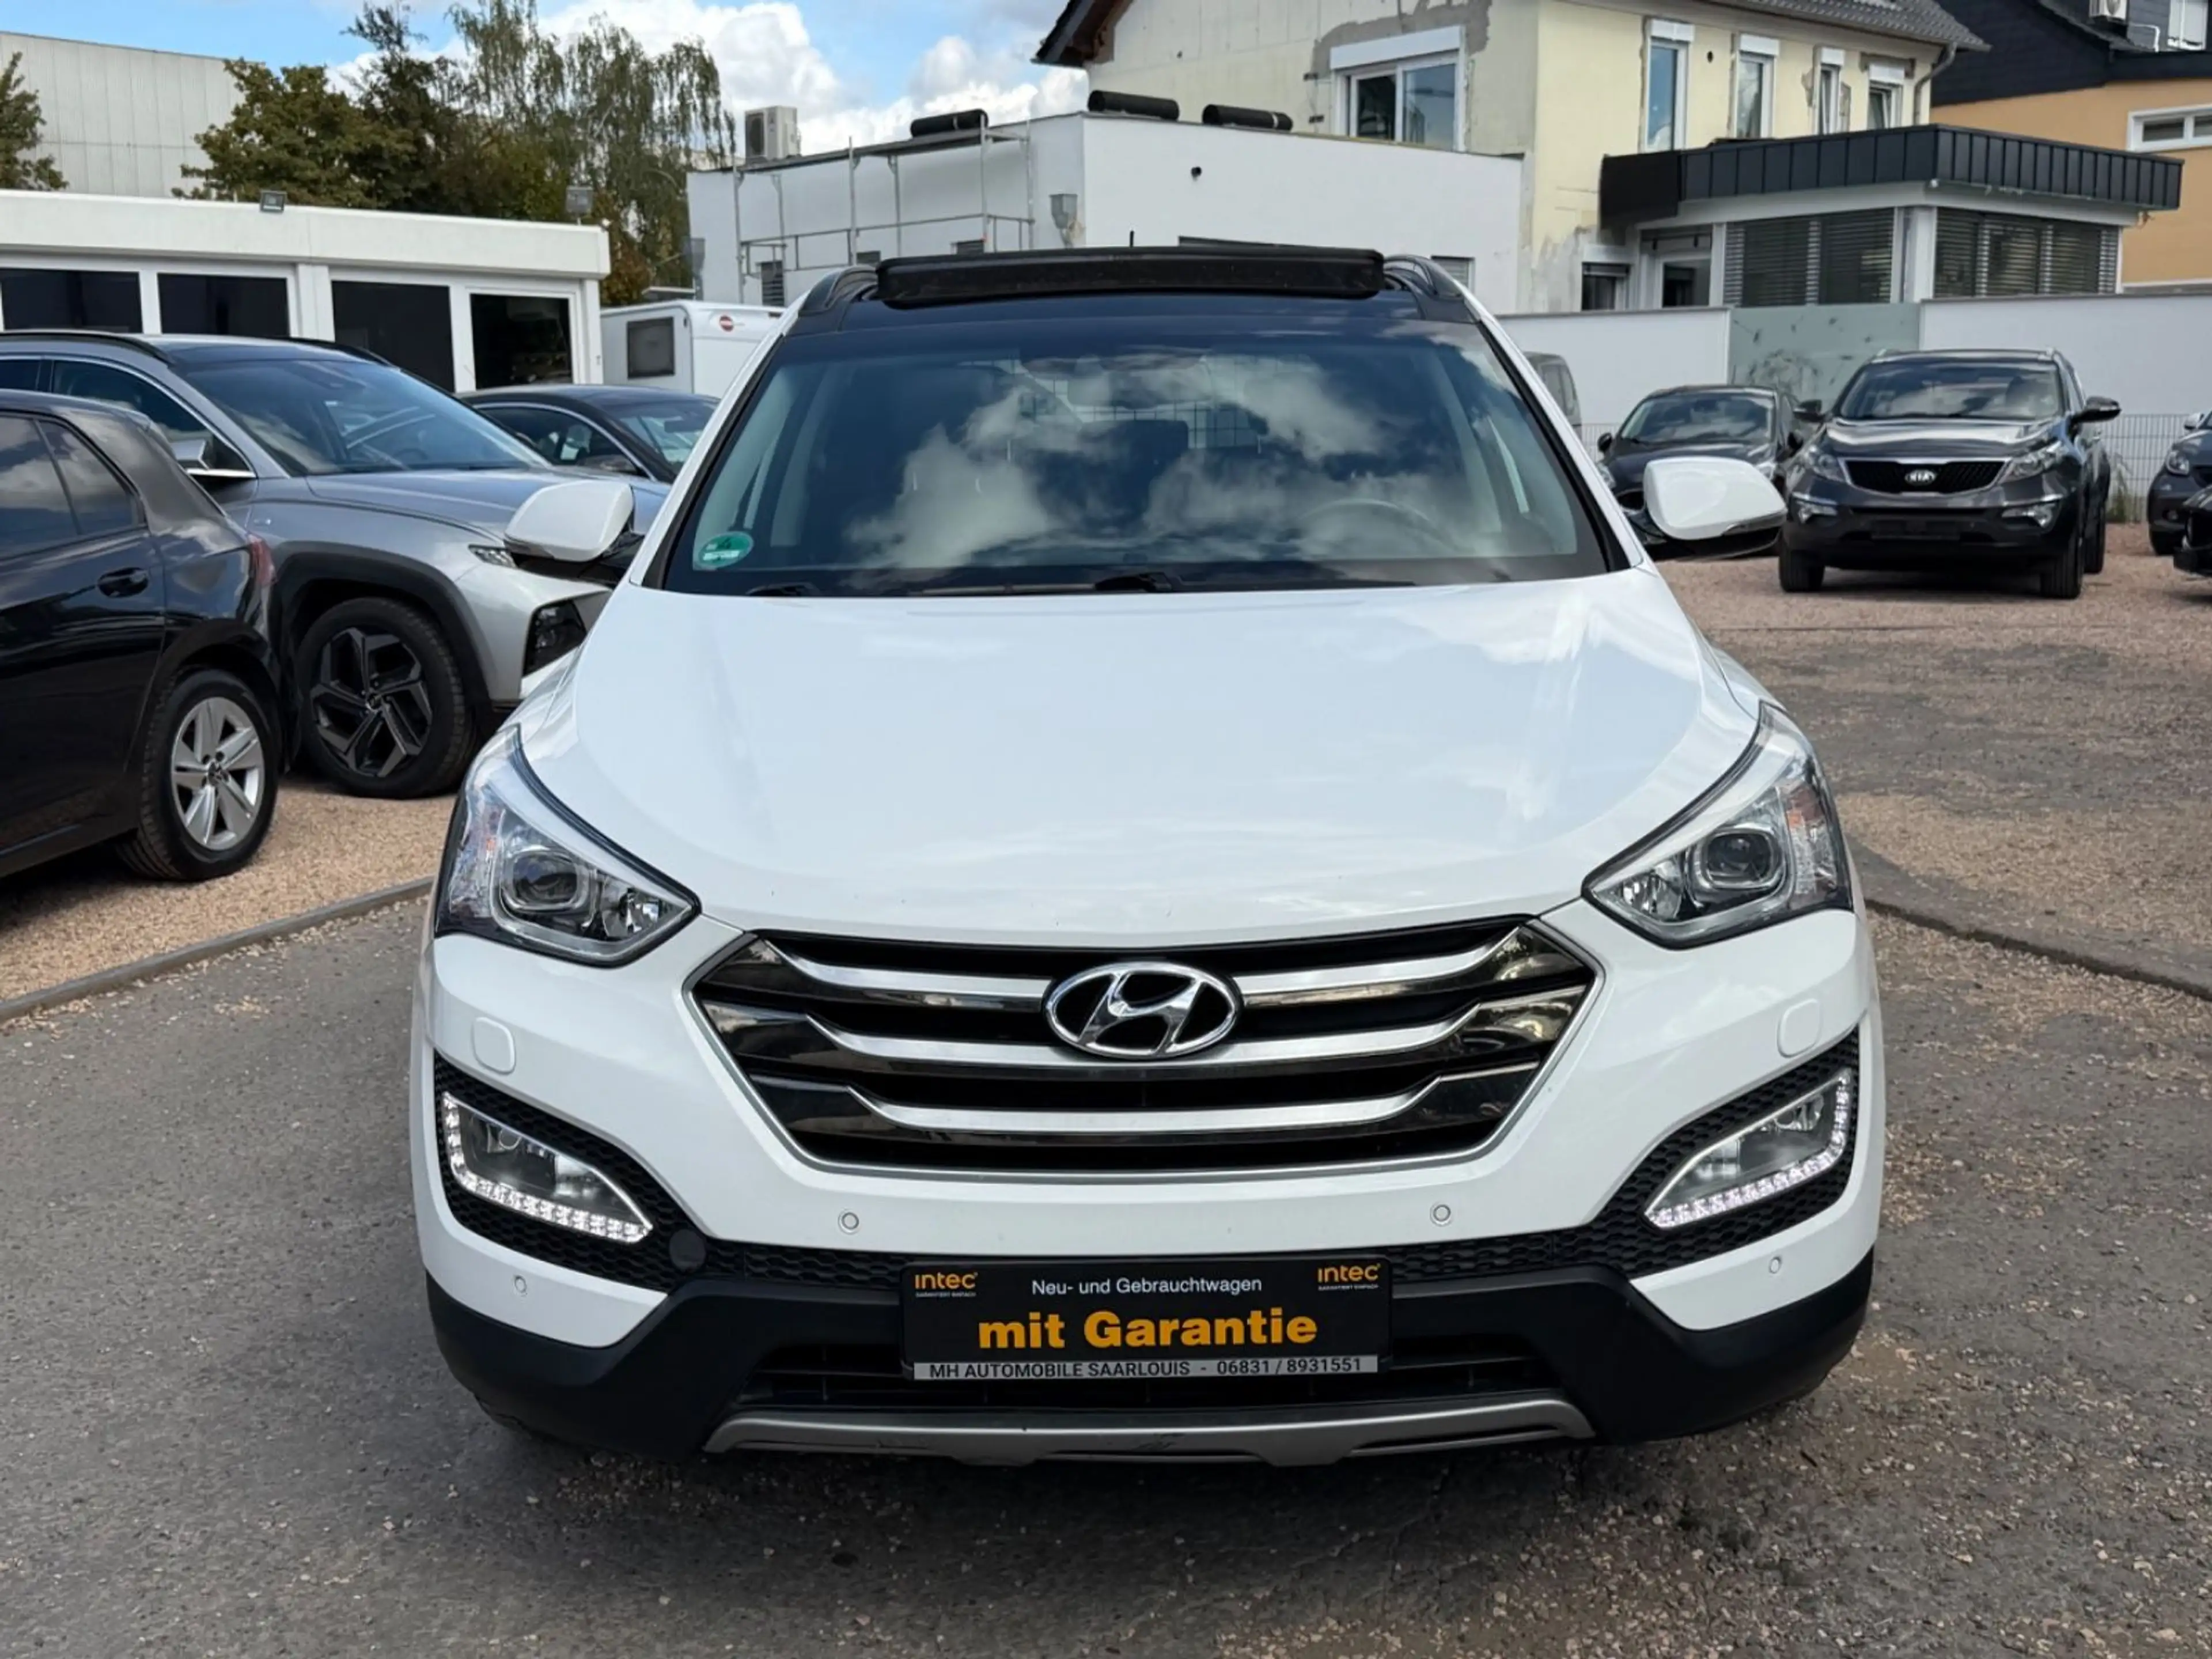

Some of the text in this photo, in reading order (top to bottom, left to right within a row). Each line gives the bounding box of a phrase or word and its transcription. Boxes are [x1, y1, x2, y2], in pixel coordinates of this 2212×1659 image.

[1908, 471, 1935, 483] KIA
[915, 1272, 976, 1289] intec
[1317, 1265, 1378, 1283] intec
[1032, 1277, 1263, 1296] Neu- und Gebrauchtwagen
[979, 1307, 1318, 1349] mit Garantie
[929, 1364, 960, 1378] MH
[964, 1362, 1084, 1378] AUTOMOBILE
[1088, 1361, 1191, 1377] SAARLOUIS
[1217, 1359, 1269, 1375] 06831
[1286, 1357, 1361, 1373] 8931551
